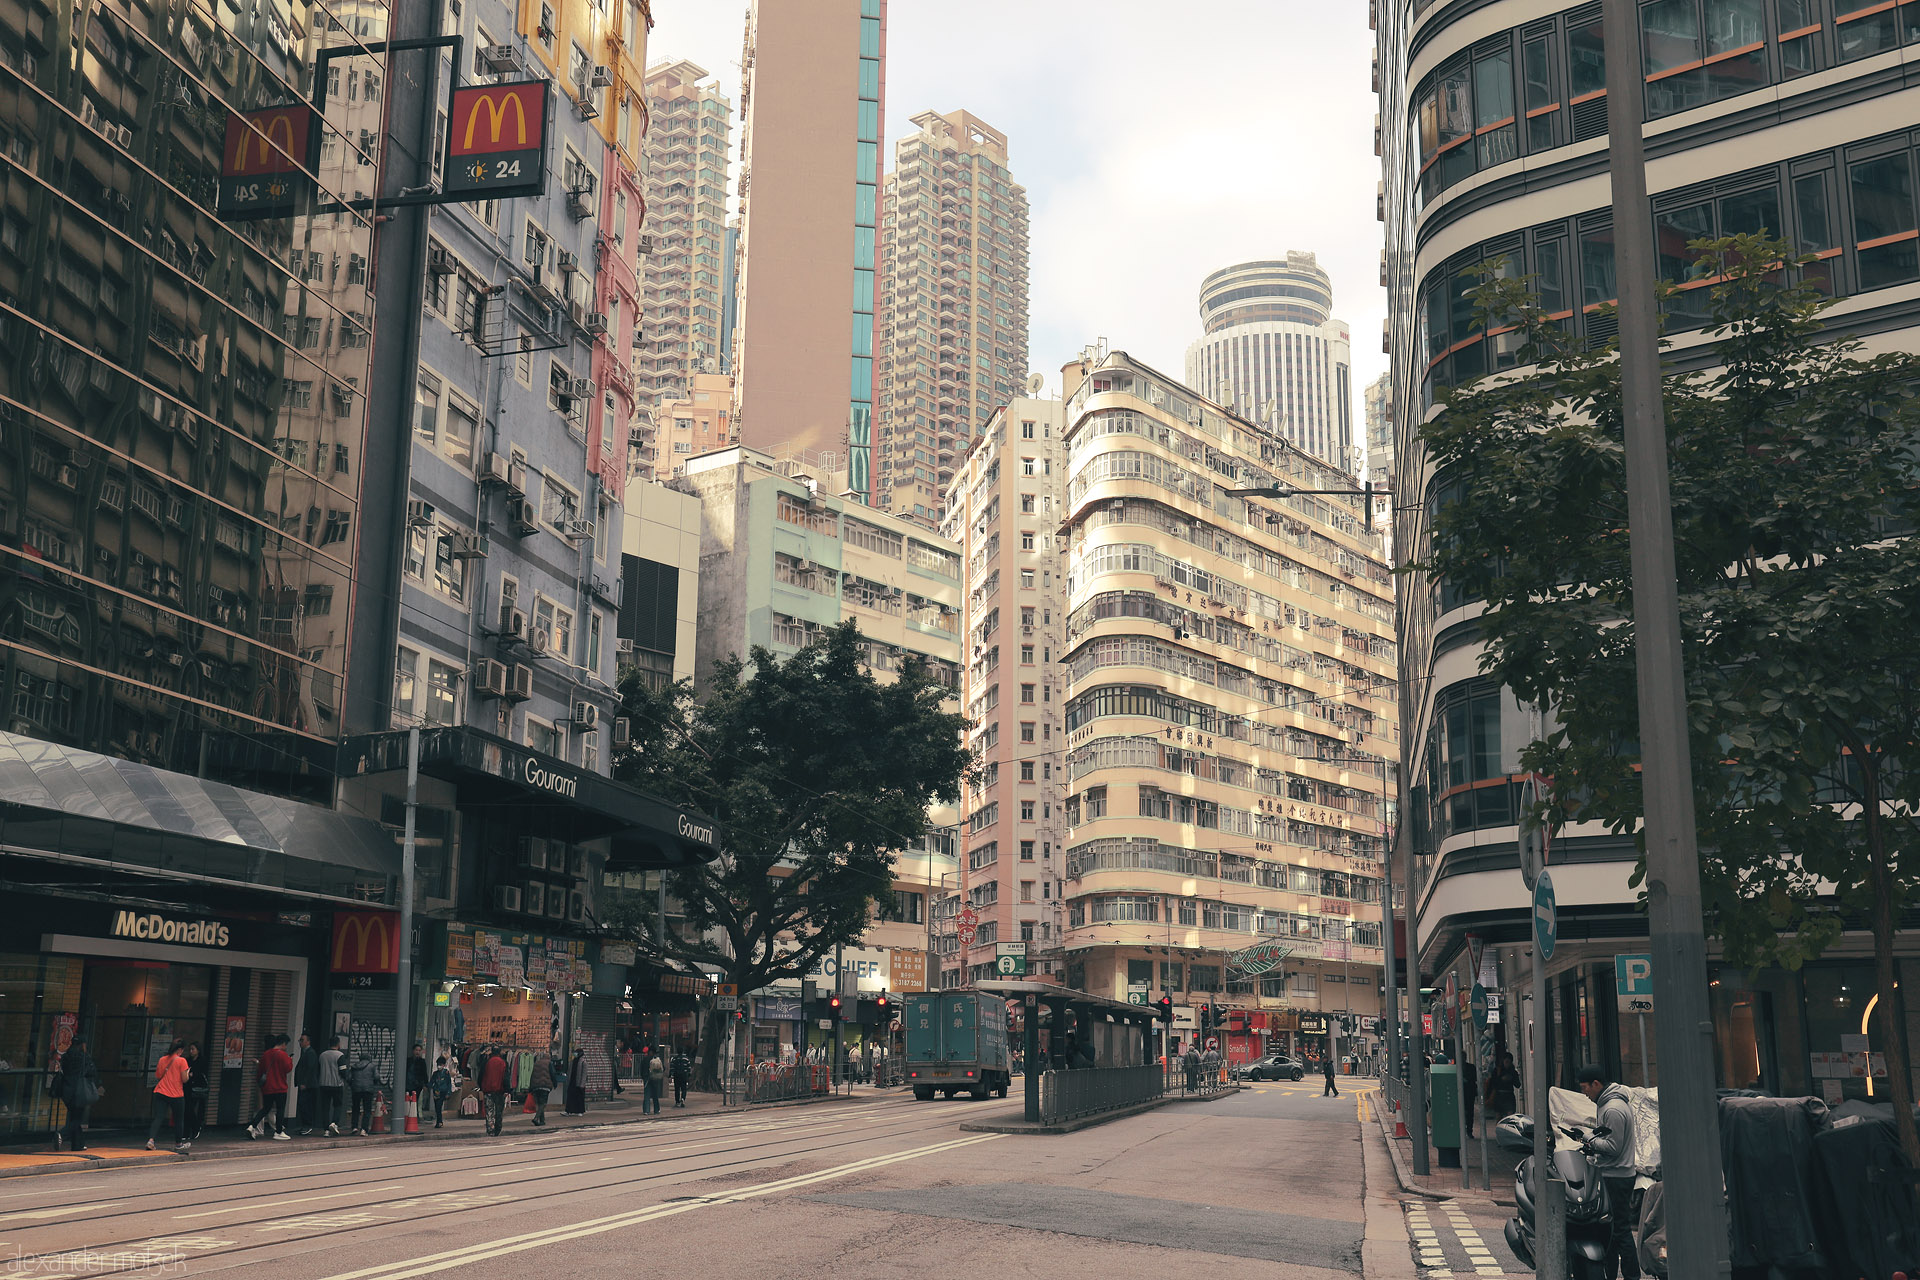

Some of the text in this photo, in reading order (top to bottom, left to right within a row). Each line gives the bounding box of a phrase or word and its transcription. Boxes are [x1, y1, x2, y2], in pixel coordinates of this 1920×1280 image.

[495, 159, 521, 179] 24
[525, 757, 578, 799] Gourami
[678, 813, 713, 845] Gourami
[114, 909, 230, 947] McDonald's
[359, 976, 373, 987] 24
[436, 994, 449, 1003] GP
